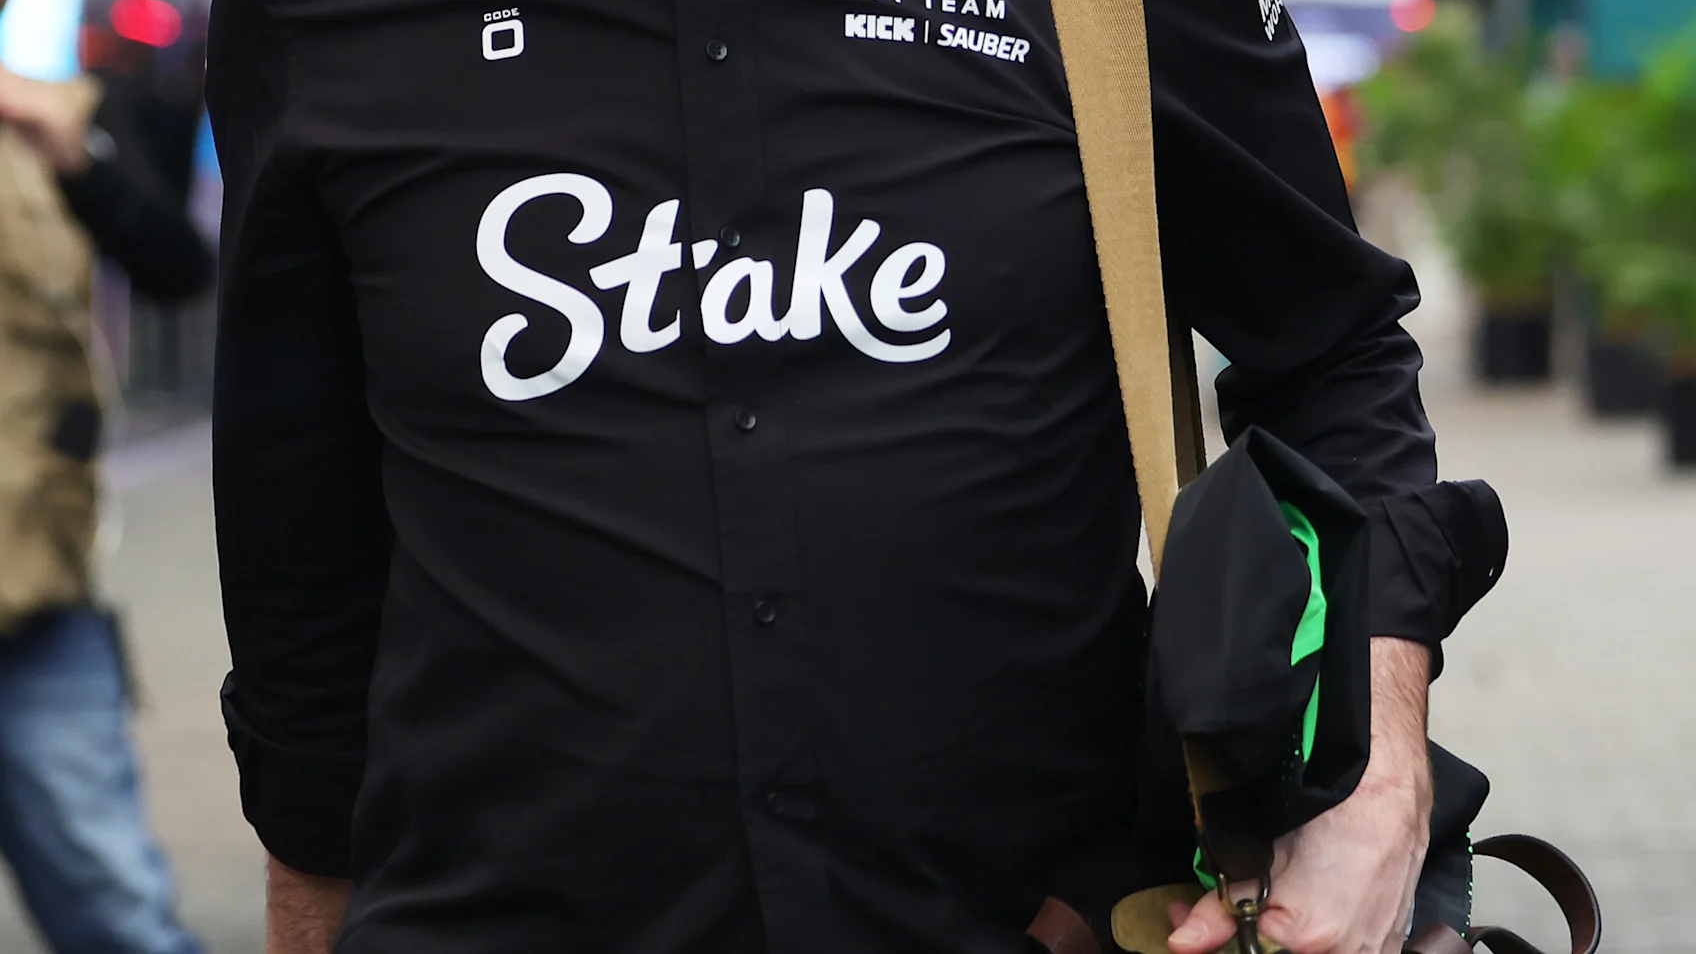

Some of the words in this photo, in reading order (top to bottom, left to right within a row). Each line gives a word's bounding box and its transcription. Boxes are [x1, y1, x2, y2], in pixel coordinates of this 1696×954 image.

[483, 7, 520, 22] CODE
[844, 13, 915, 42] KICK
[937, 23, 1030, 63] SAUBER
[476, 173, 951, 401] Stake
